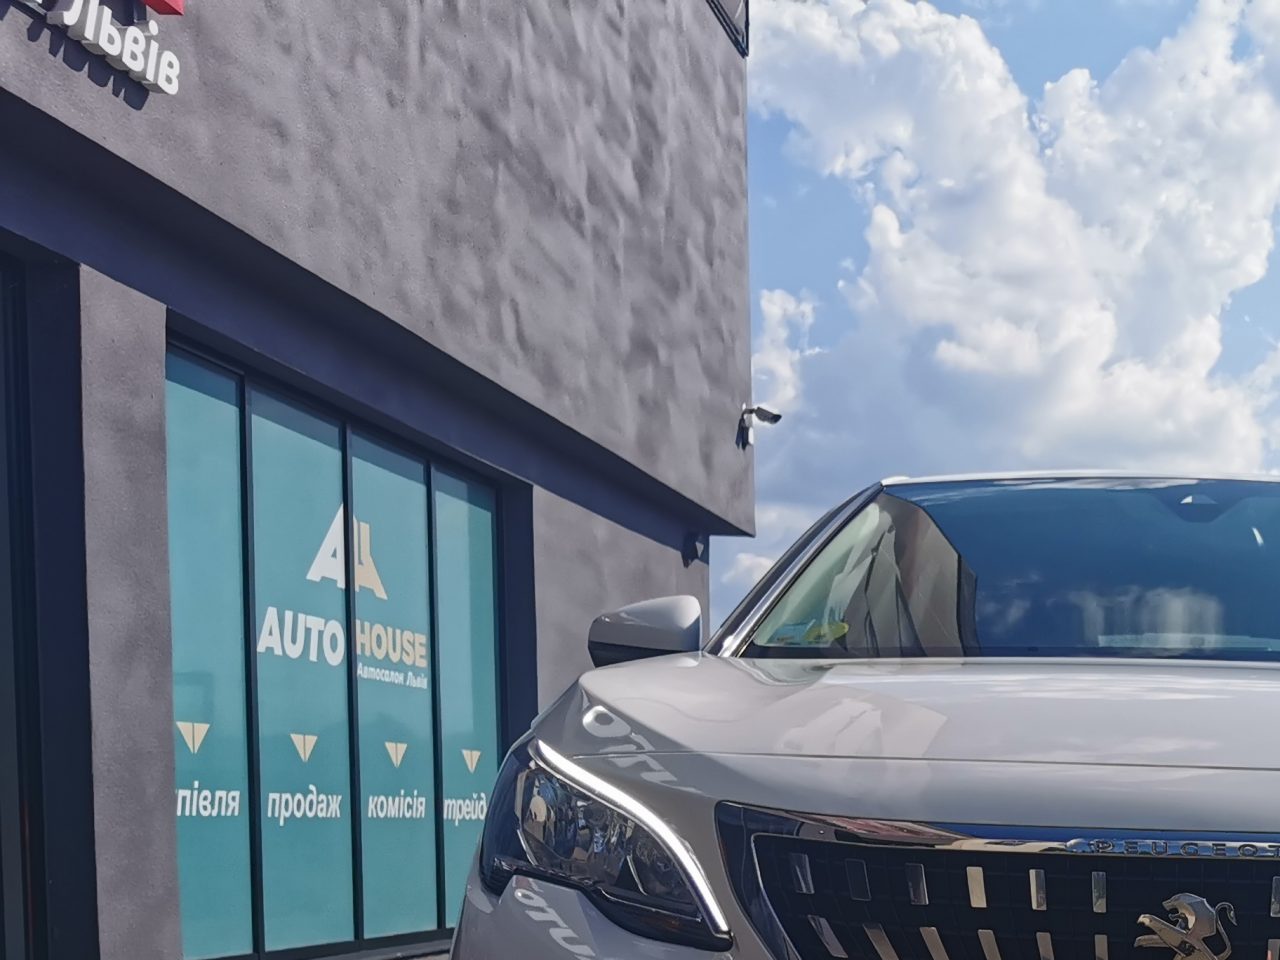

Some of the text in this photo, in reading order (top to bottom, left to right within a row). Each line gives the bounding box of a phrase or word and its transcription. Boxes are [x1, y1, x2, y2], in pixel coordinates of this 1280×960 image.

[256, 606, 428, 669] AUTO HOUSE
[356, 661, 405, 686] Автосалон
[175, 779, 241, 818] півля
[266, 784, 343, 827] продаж
[367, 788, 426, 820] комісія
